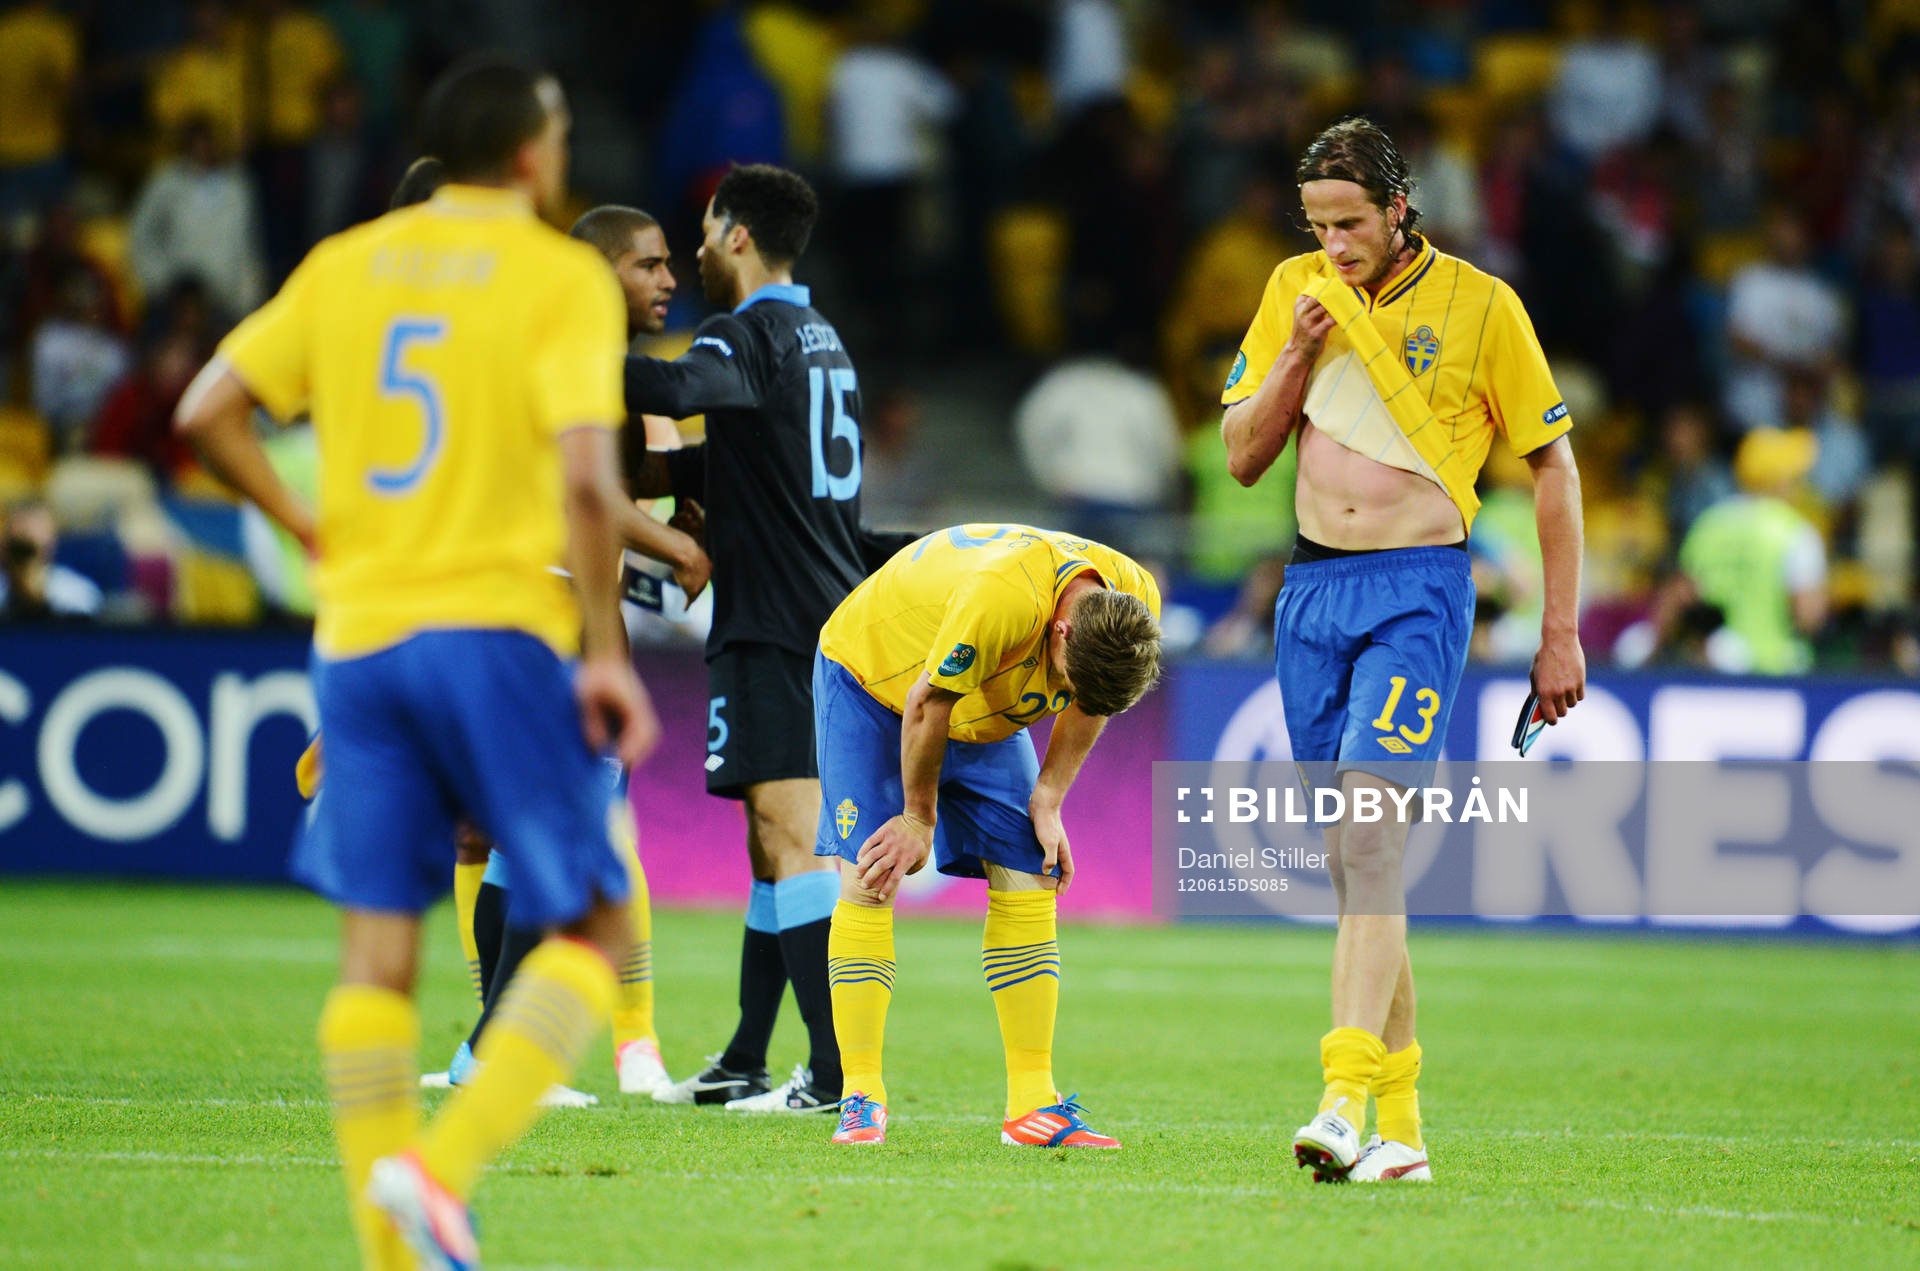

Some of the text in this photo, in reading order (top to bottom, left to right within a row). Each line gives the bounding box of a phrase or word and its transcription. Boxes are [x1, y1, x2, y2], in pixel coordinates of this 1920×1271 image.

[366, 317, 448, 495] 5
[809, 367, 862, 500] 15
[707, 696, 729, 752] 5
[1372, 676, 1440, 744] 13
[1472, 680, 1920, 934] RES
